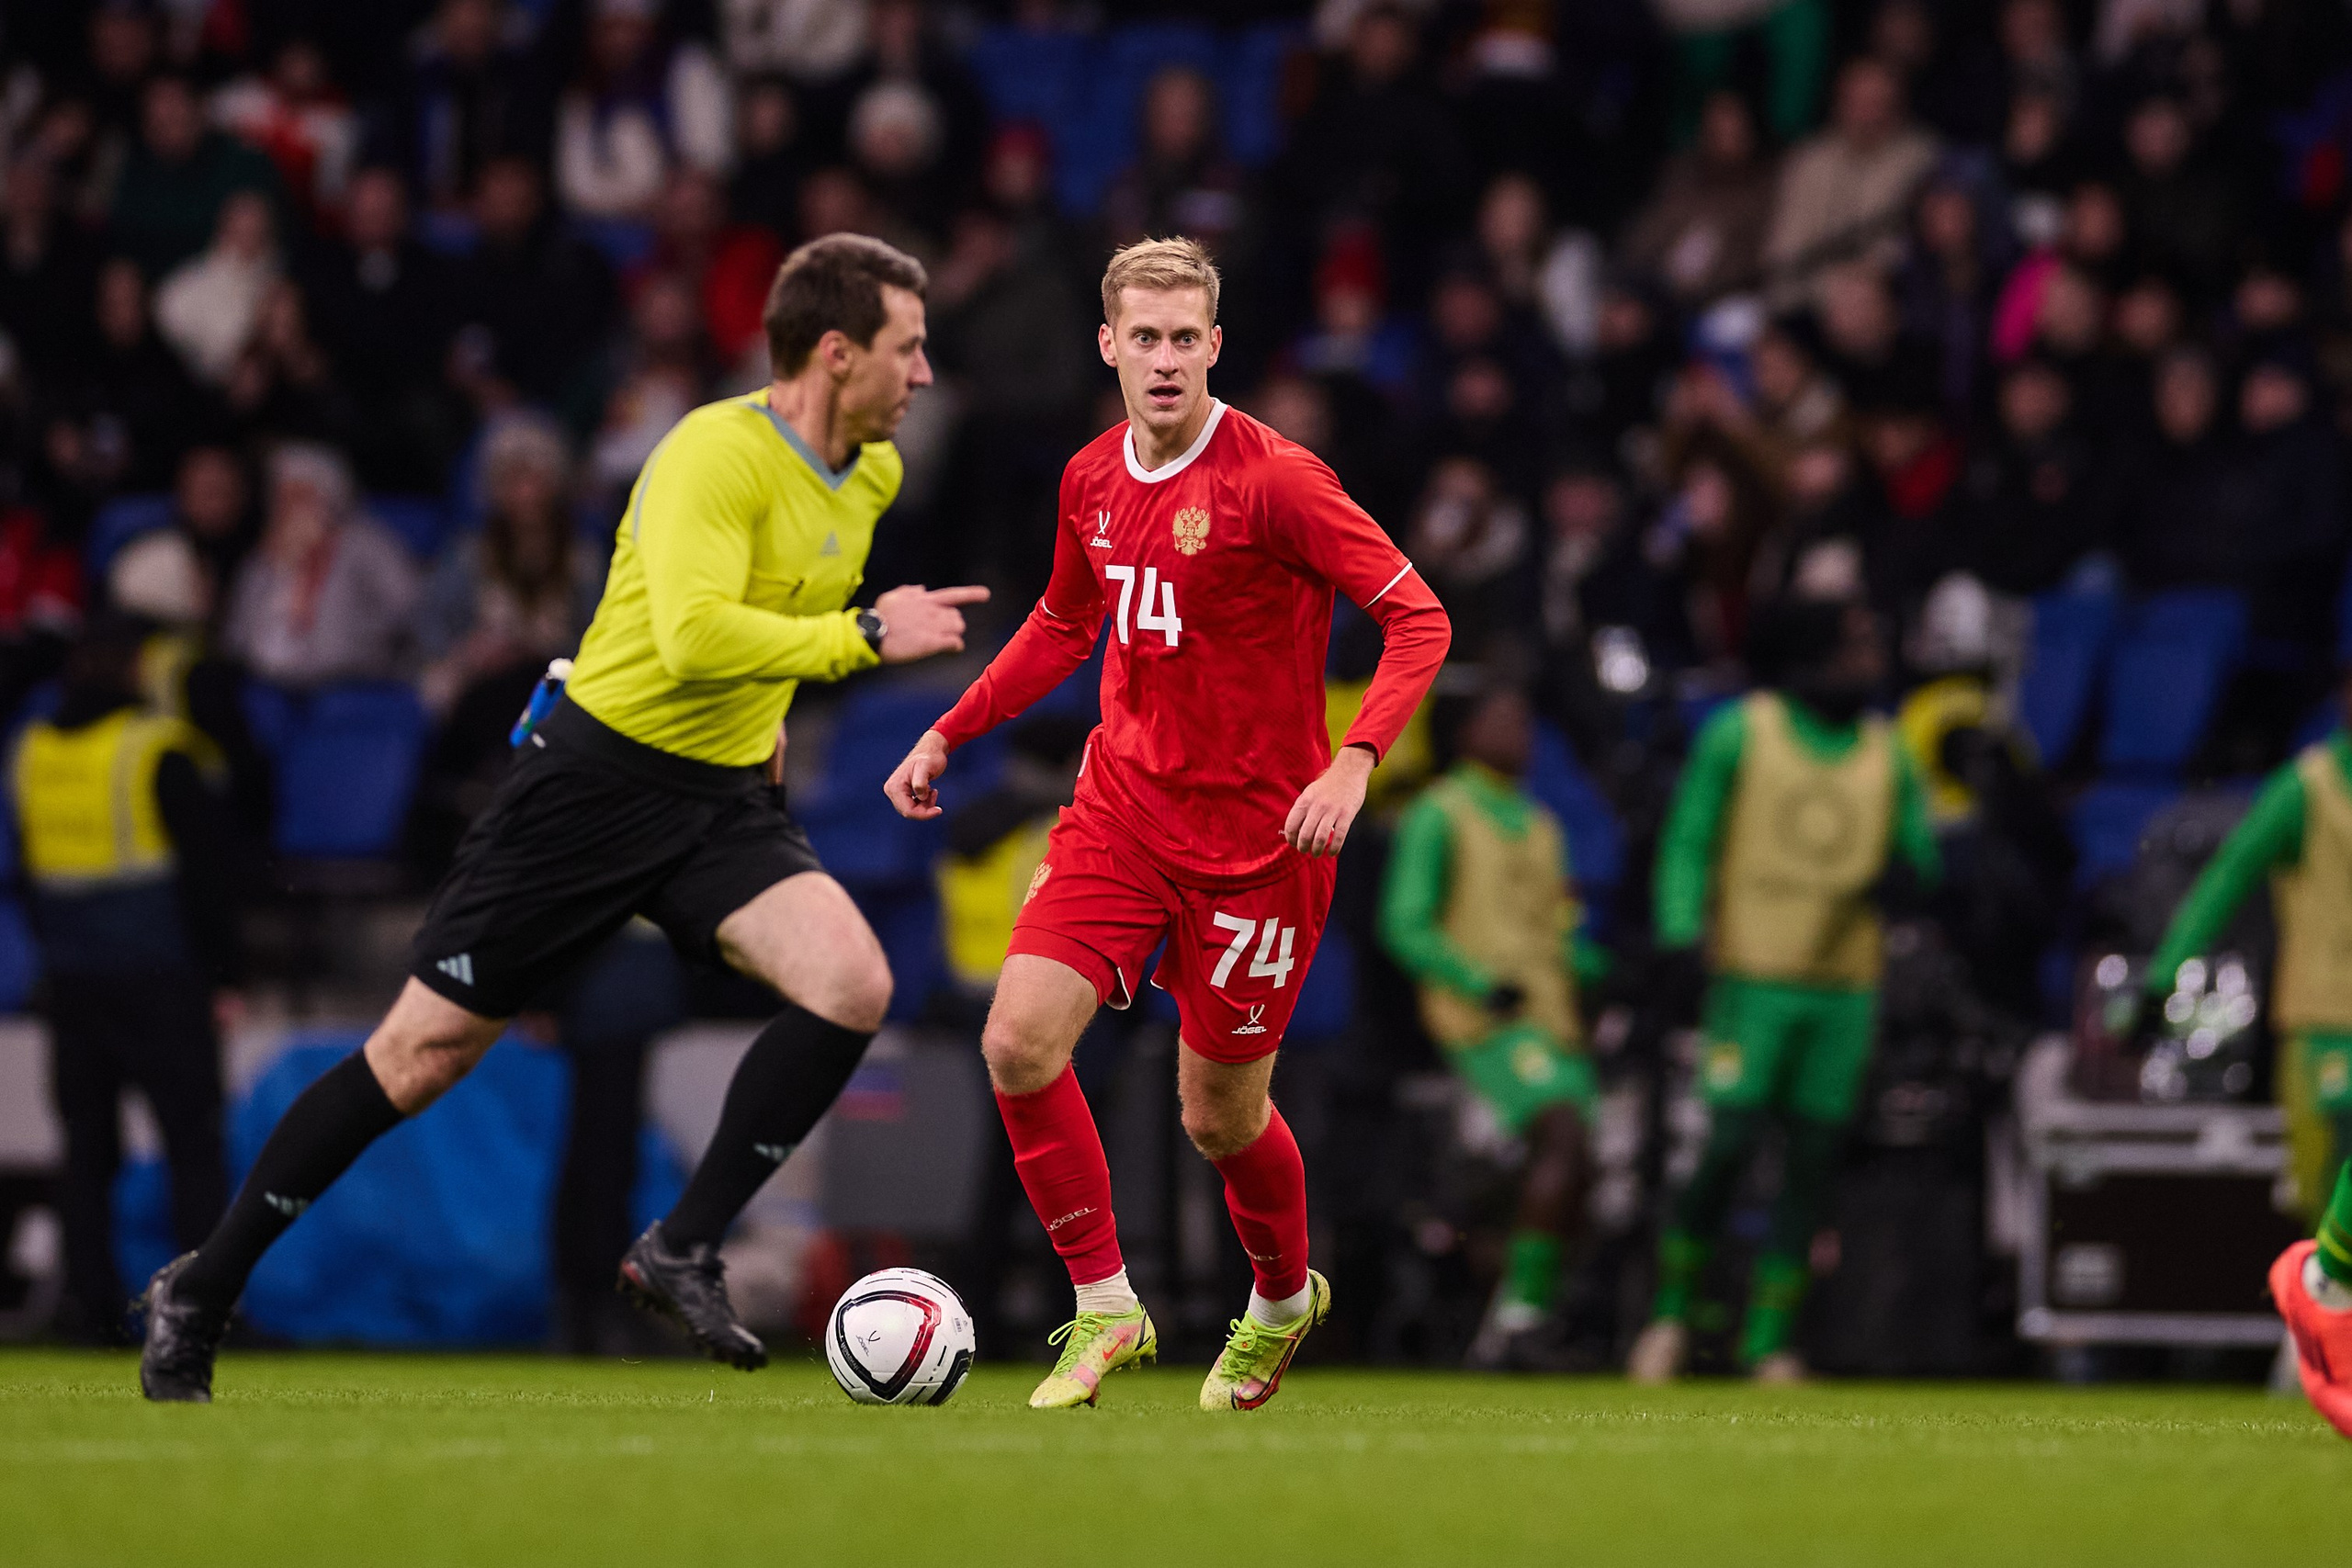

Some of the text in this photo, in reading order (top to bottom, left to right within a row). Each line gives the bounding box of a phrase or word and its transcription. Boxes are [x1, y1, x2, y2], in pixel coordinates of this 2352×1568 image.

[1090, 536, 1113, 548] JÖGEL
[1105, 565, 1182, 647] 74
[1210, 911, 1295, 988] 74
[1231, 1025, 1267, 1034] JÖGEL
[1046, 1207, 1098, 1231] JÖGEL
